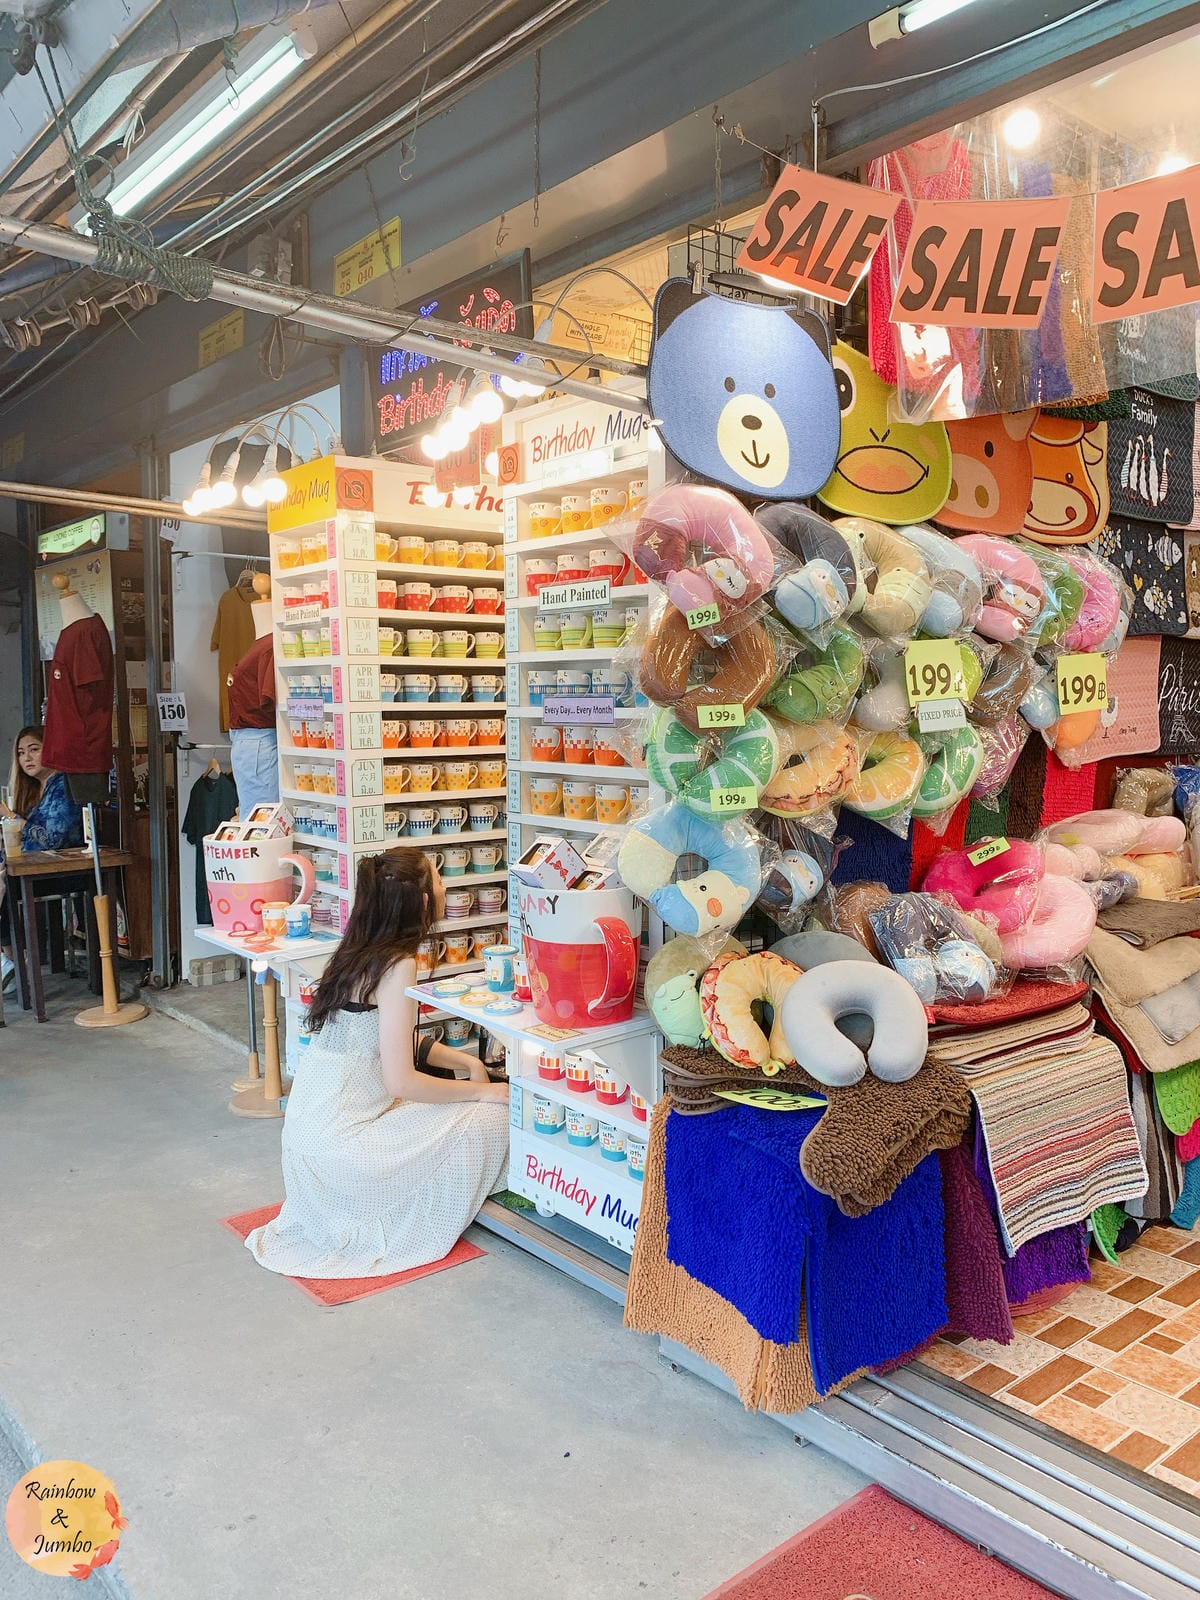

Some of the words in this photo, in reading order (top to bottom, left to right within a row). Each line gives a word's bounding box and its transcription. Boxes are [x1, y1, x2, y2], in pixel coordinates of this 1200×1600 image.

[746, 189, 888, 291] SALE
[357, 265, 374, 284] 040
[899, 225, 1061, 315] SALE
[586, 332, 603, 341] CARE
[1131, 403, 1158, 428] Family
[531, 420, 596, 464] Birthday
[308, 478, 330, 503] Mug
[352, 573, 370, 584] FEB
[541, 589, 567, 605] Hand
[570, 585, 607, 602] Painted
[285, 609, 299, 621] Hand
[300, 607, 319, 620] Painted
[353, 620, 371, 631] MAR
[355, 667, 372, 677] APR
[356, 678, 373, 688] 四月
[160, 704, 186, 720] 150
[544, 705, 559, 715] Every
[560, 705, 576, 715] Day...
[576, 705, 592, 716] Every
[593, 705, 612, 714] Month
[920, 711, 942, 720] FIXED
[943, 708, 963, 719] PRICE
[357, 714, 374, 724] MAY
[359, 725, 375, 735] 五月
[358, 761, 376, 771] JUN
[359, 772, 376, 782] 六月
[359, 808, 377, 818] JUL
[359, 820, 376, 829] 七月
[526, 1154, 597, 1216] Birthday
